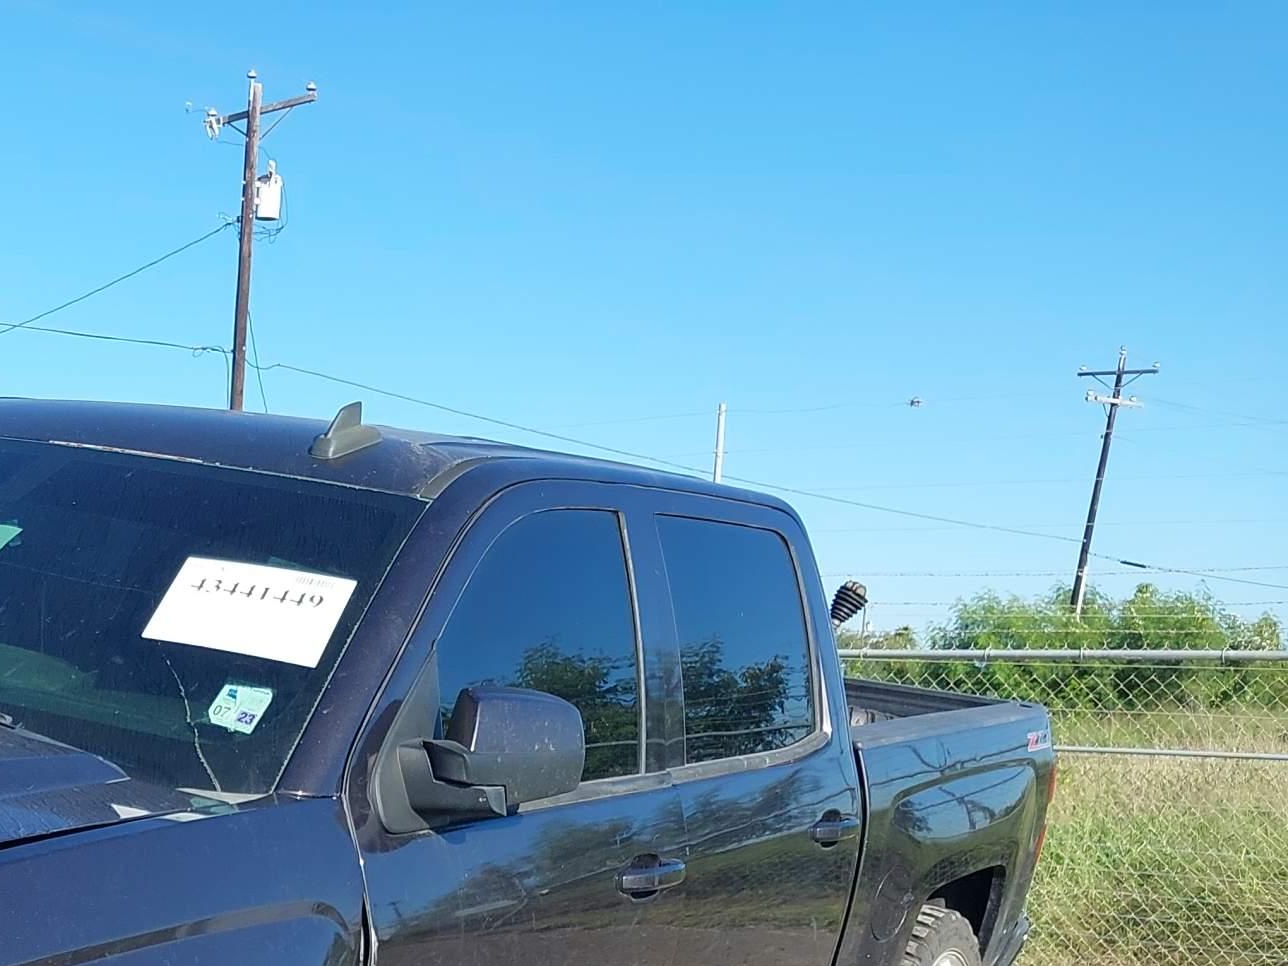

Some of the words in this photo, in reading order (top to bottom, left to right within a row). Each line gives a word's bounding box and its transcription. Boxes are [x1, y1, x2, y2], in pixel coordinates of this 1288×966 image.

[191, 577, 324, 608] 43441449
[213, 704, 232, 718] 07
[237, 711, 256, 725] 23
